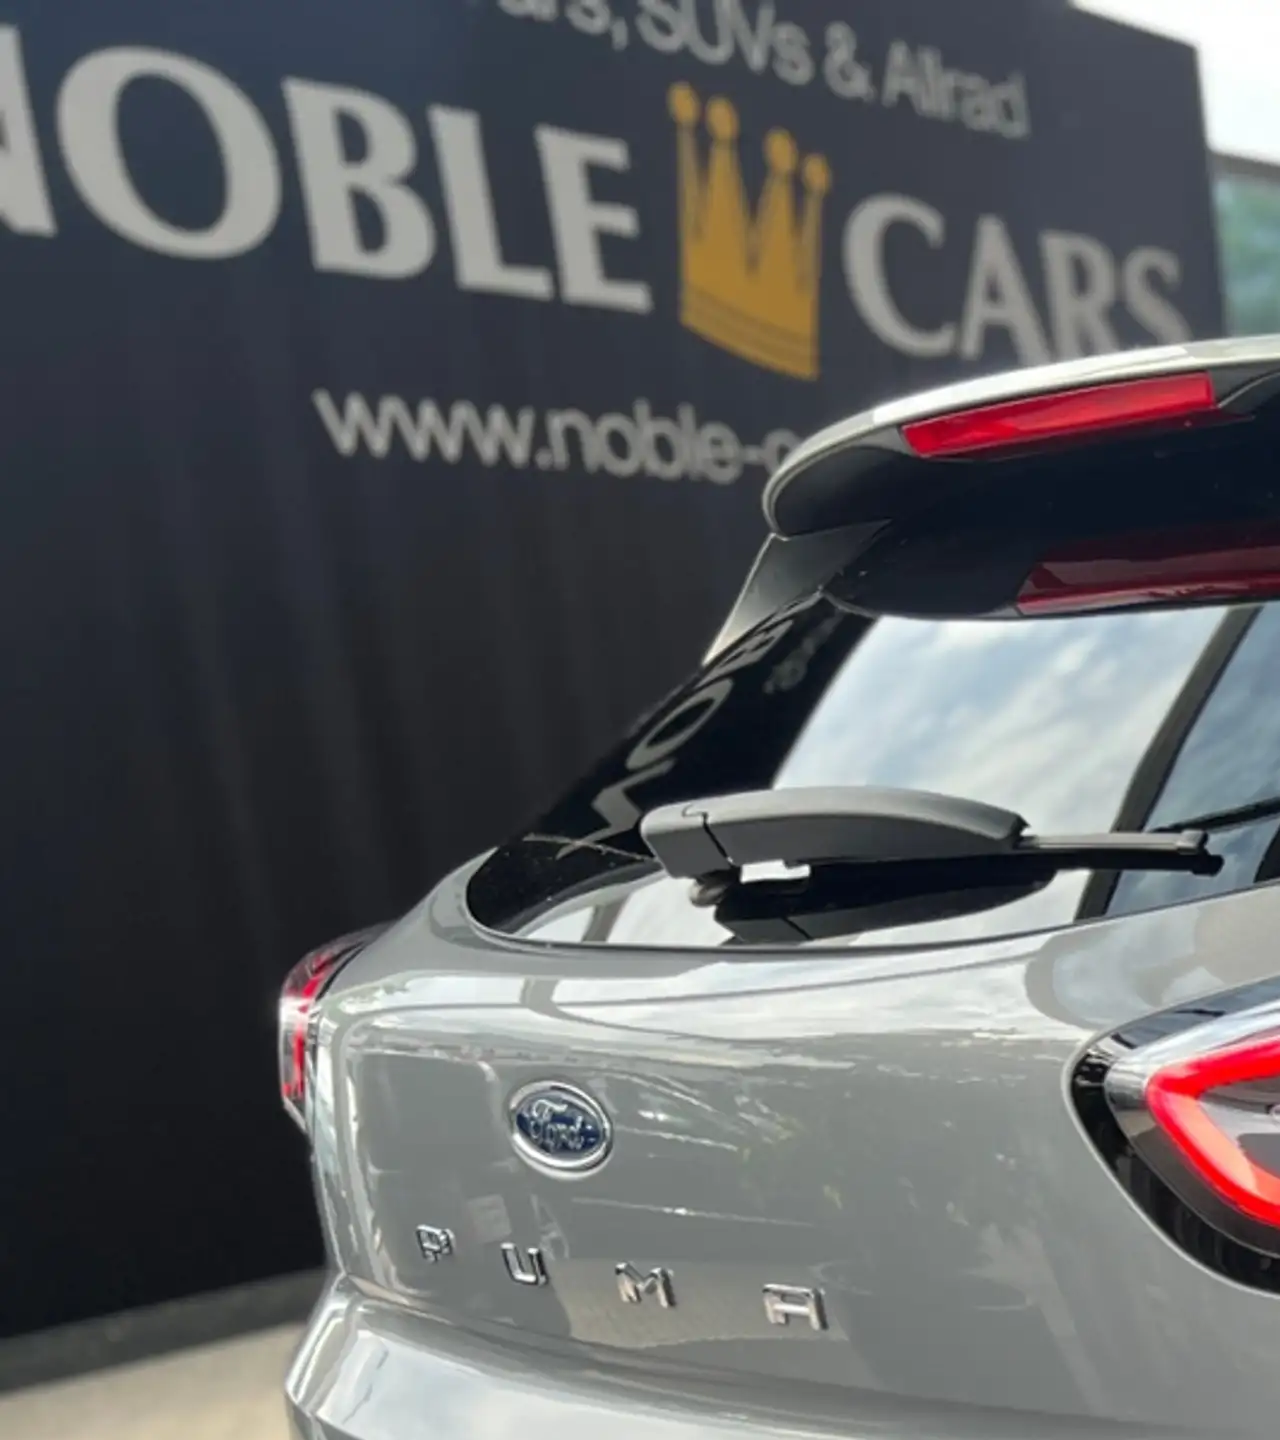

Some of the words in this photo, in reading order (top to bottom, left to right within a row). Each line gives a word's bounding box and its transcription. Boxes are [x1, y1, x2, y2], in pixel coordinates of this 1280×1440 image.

[635, 0, 816, 87] SUVs
[822, 20, 877, 104] &
[881, 38, 1031, 141] Allrad
[0, 24, 653, 314] OBLE
[841, 191, 1196, 370] CARS
